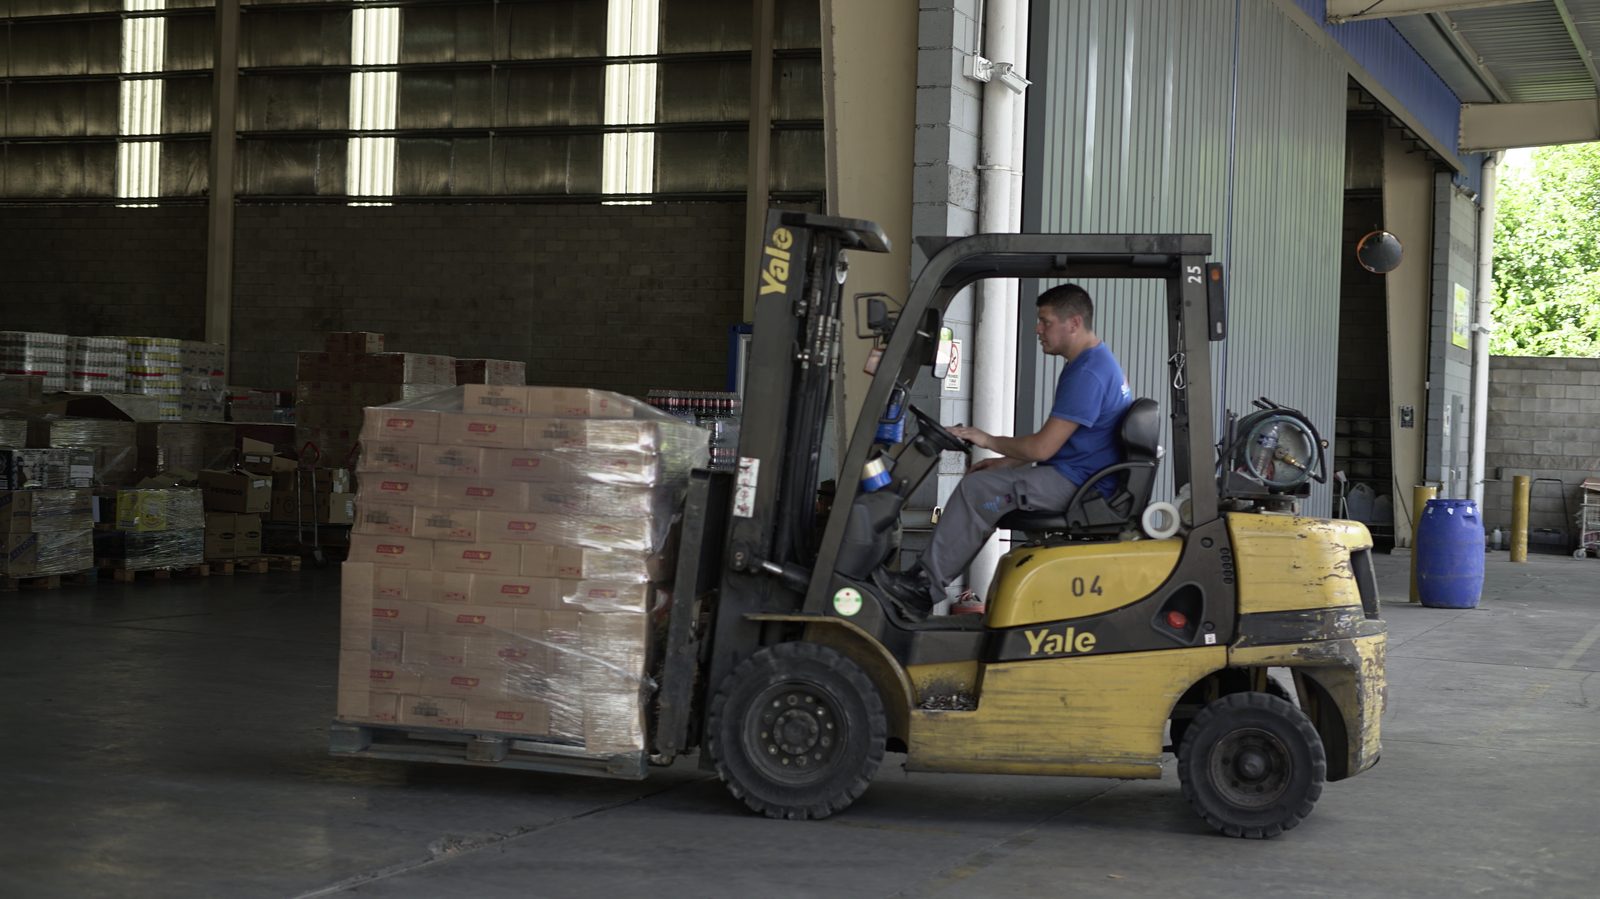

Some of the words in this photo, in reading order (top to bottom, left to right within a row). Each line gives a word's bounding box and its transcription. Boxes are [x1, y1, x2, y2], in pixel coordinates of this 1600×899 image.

[760, 227, 793, 295] Yale
[1187, 266, 1202, 284] 25
[1072, 575, 1103, 597] 04
[1024, 627, 1096, 656] Yale
